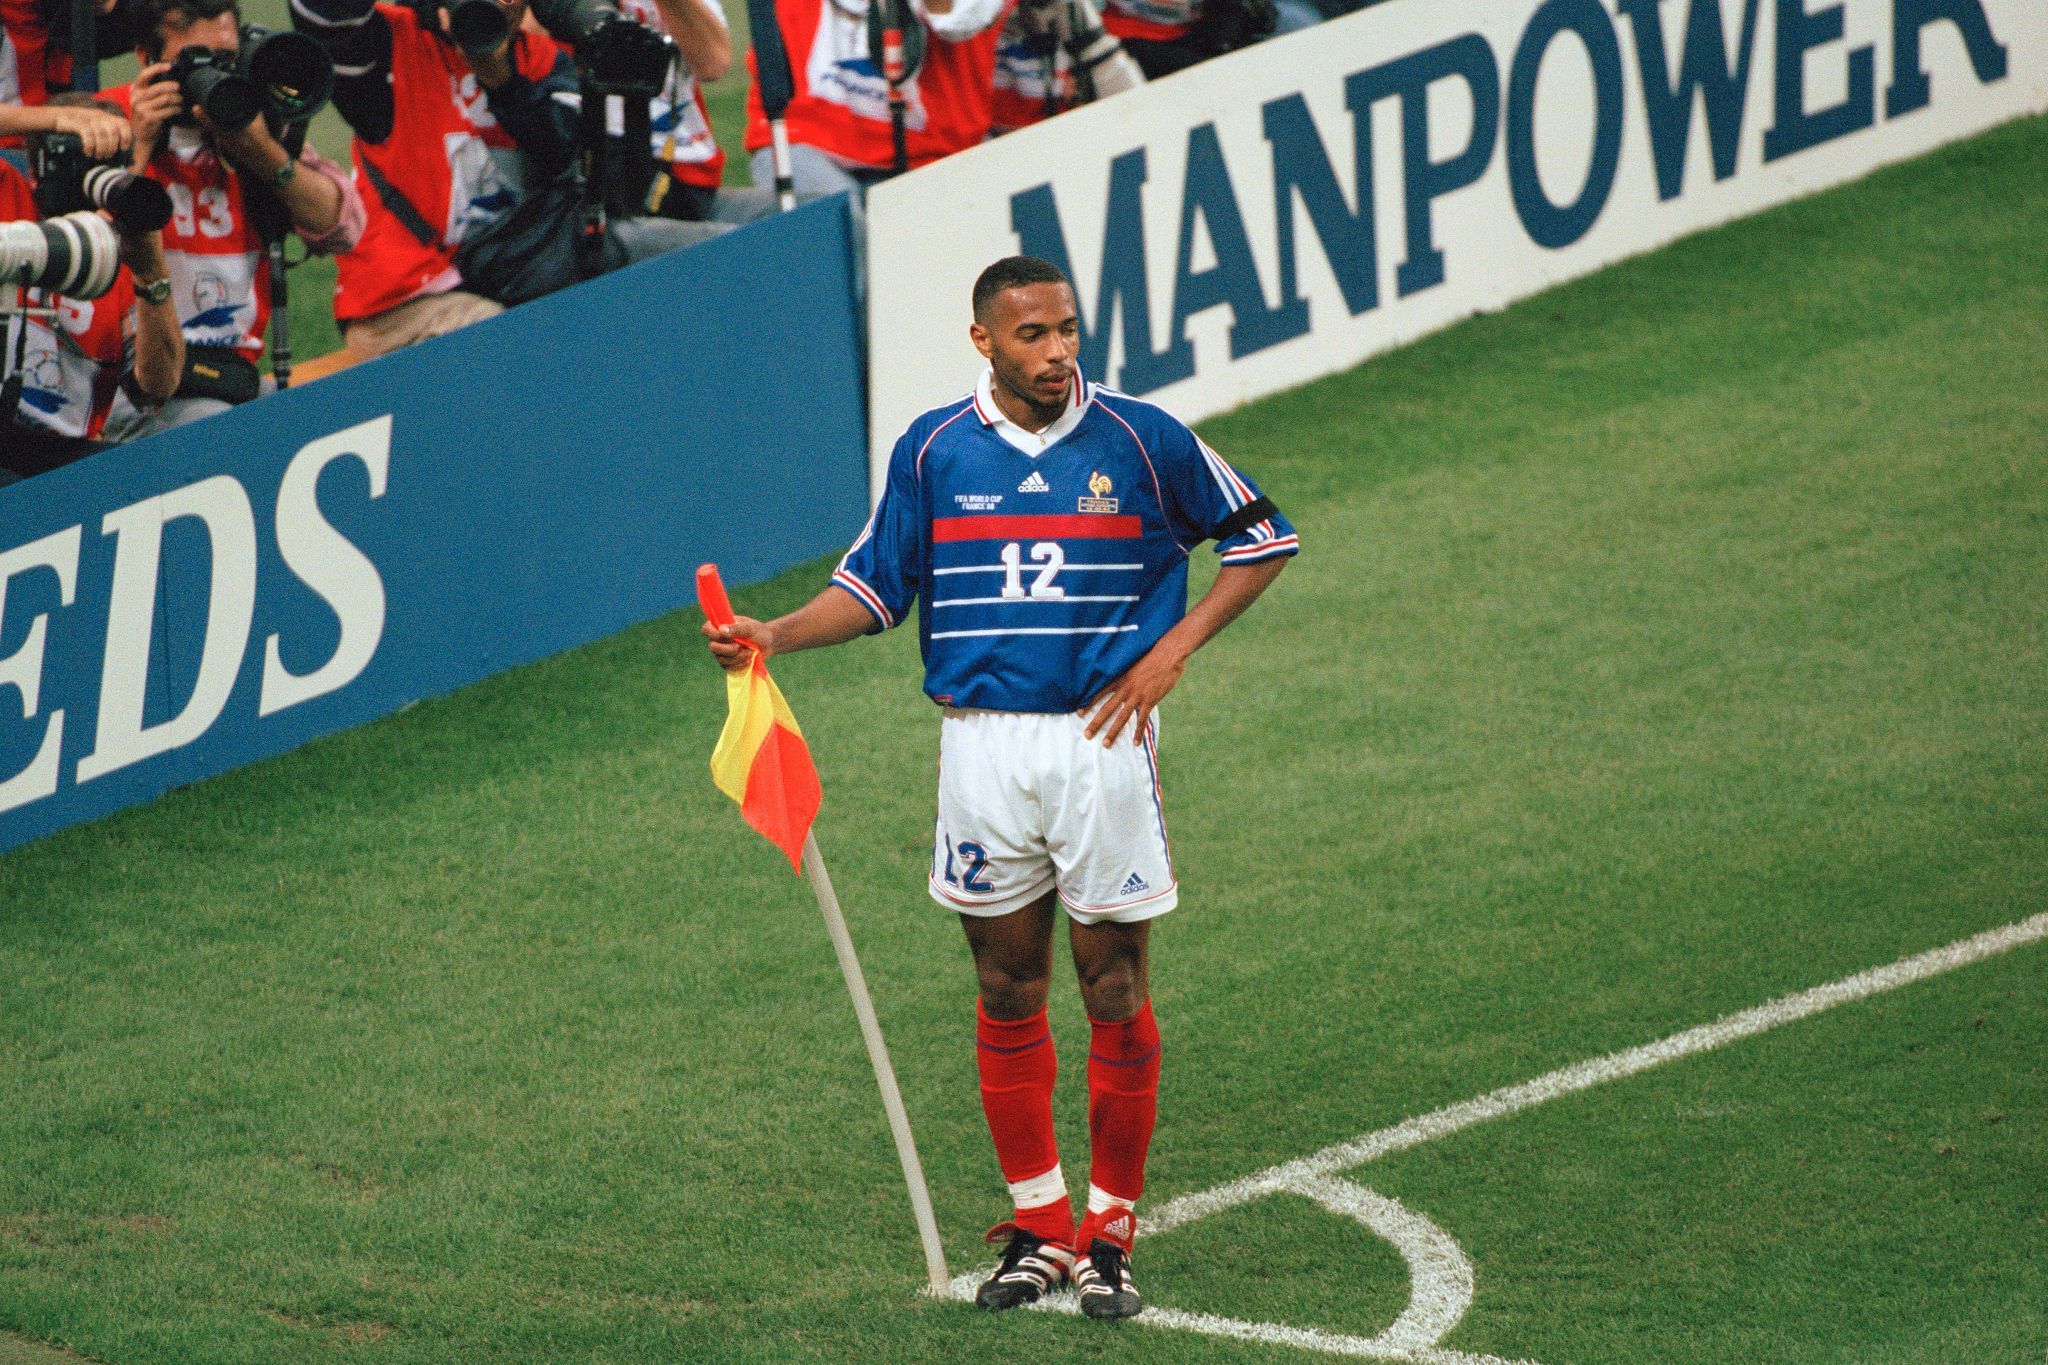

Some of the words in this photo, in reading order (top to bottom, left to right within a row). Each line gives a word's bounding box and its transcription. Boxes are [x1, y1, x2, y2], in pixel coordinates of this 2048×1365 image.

[1018, 482, 1049, 493] adidas
[955, 495, 968, 503] FIFA
[968, 495, 990, 503] WORLD
[990, 495, 1003, 503] CUP
[1001, 542, 1065, 599] 12
[944, 832, 996, 894] 12
[1121, 881, 1149, 896] adidas
